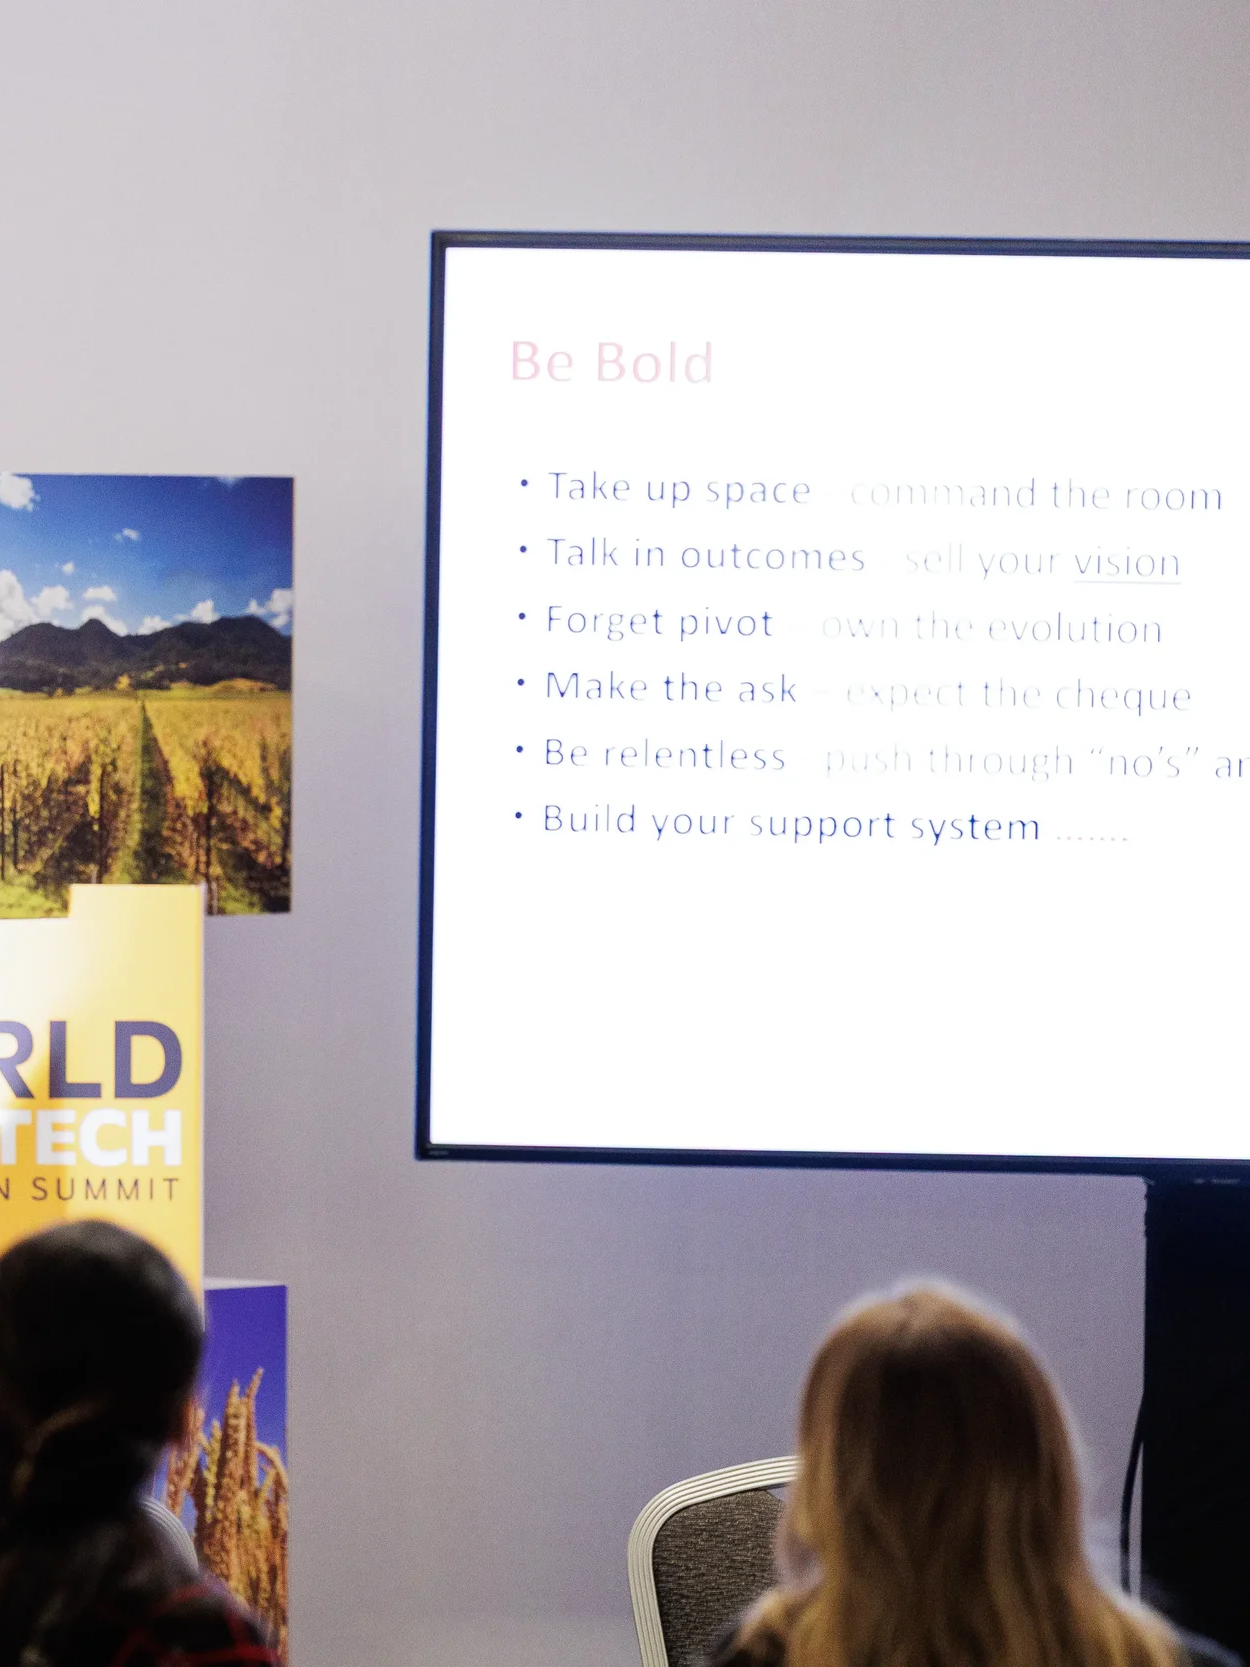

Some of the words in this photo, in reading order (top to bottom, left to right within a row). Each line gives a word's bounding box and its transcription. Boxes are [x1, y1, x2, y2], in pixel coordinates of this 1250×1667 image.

[513, 341, 572, 381] Be
[598, 341, 711, 383] Bold
[548, 471, 630, 501] Take
[648, 481, 690, 508] up
[707, 482, 810, 510] space
[851, 478, 1034, 508] command
[1052, 479, 1109, 509] the
[1127, 488, 1222, 510] room
[547, 537, 618, 566] Talk
[635, 539, 664, 567] in
[681, 544, 864, 571] outcomes
[906, 542, 963, 572] sell
[979, 553, 1058, 580] your
[1075, 546, 1180, 577] vision
[548, 606, 663, 641] Forget
[680, 607, 773, 642] pivot
[822, 616, 898, 639] own
[915, 609, 972, 640] the
[989, 612, 1161, 644] evolution
[547, 671, 647, 701] Make
[663, 672, 722, 702] the
[739, 674, 796, 703] ask
[847, 681, 964, 711] expect
[983, 678, 1040, 707] the
[1057, 678, 1190, 717] cheque
[546, 739, 587, 766] Be
[606, 738, 785, 770] relentless
[826, 742, 912, 778] push
[930, 745, 1072, 781] through
[545, 804, 635, 833] Build
[652, 814, 734, 841] your
[751, 813, 895, 844] support
[911, 814, 1039, 846] system
[31, 1176, 180, 1201] SUMMIT
